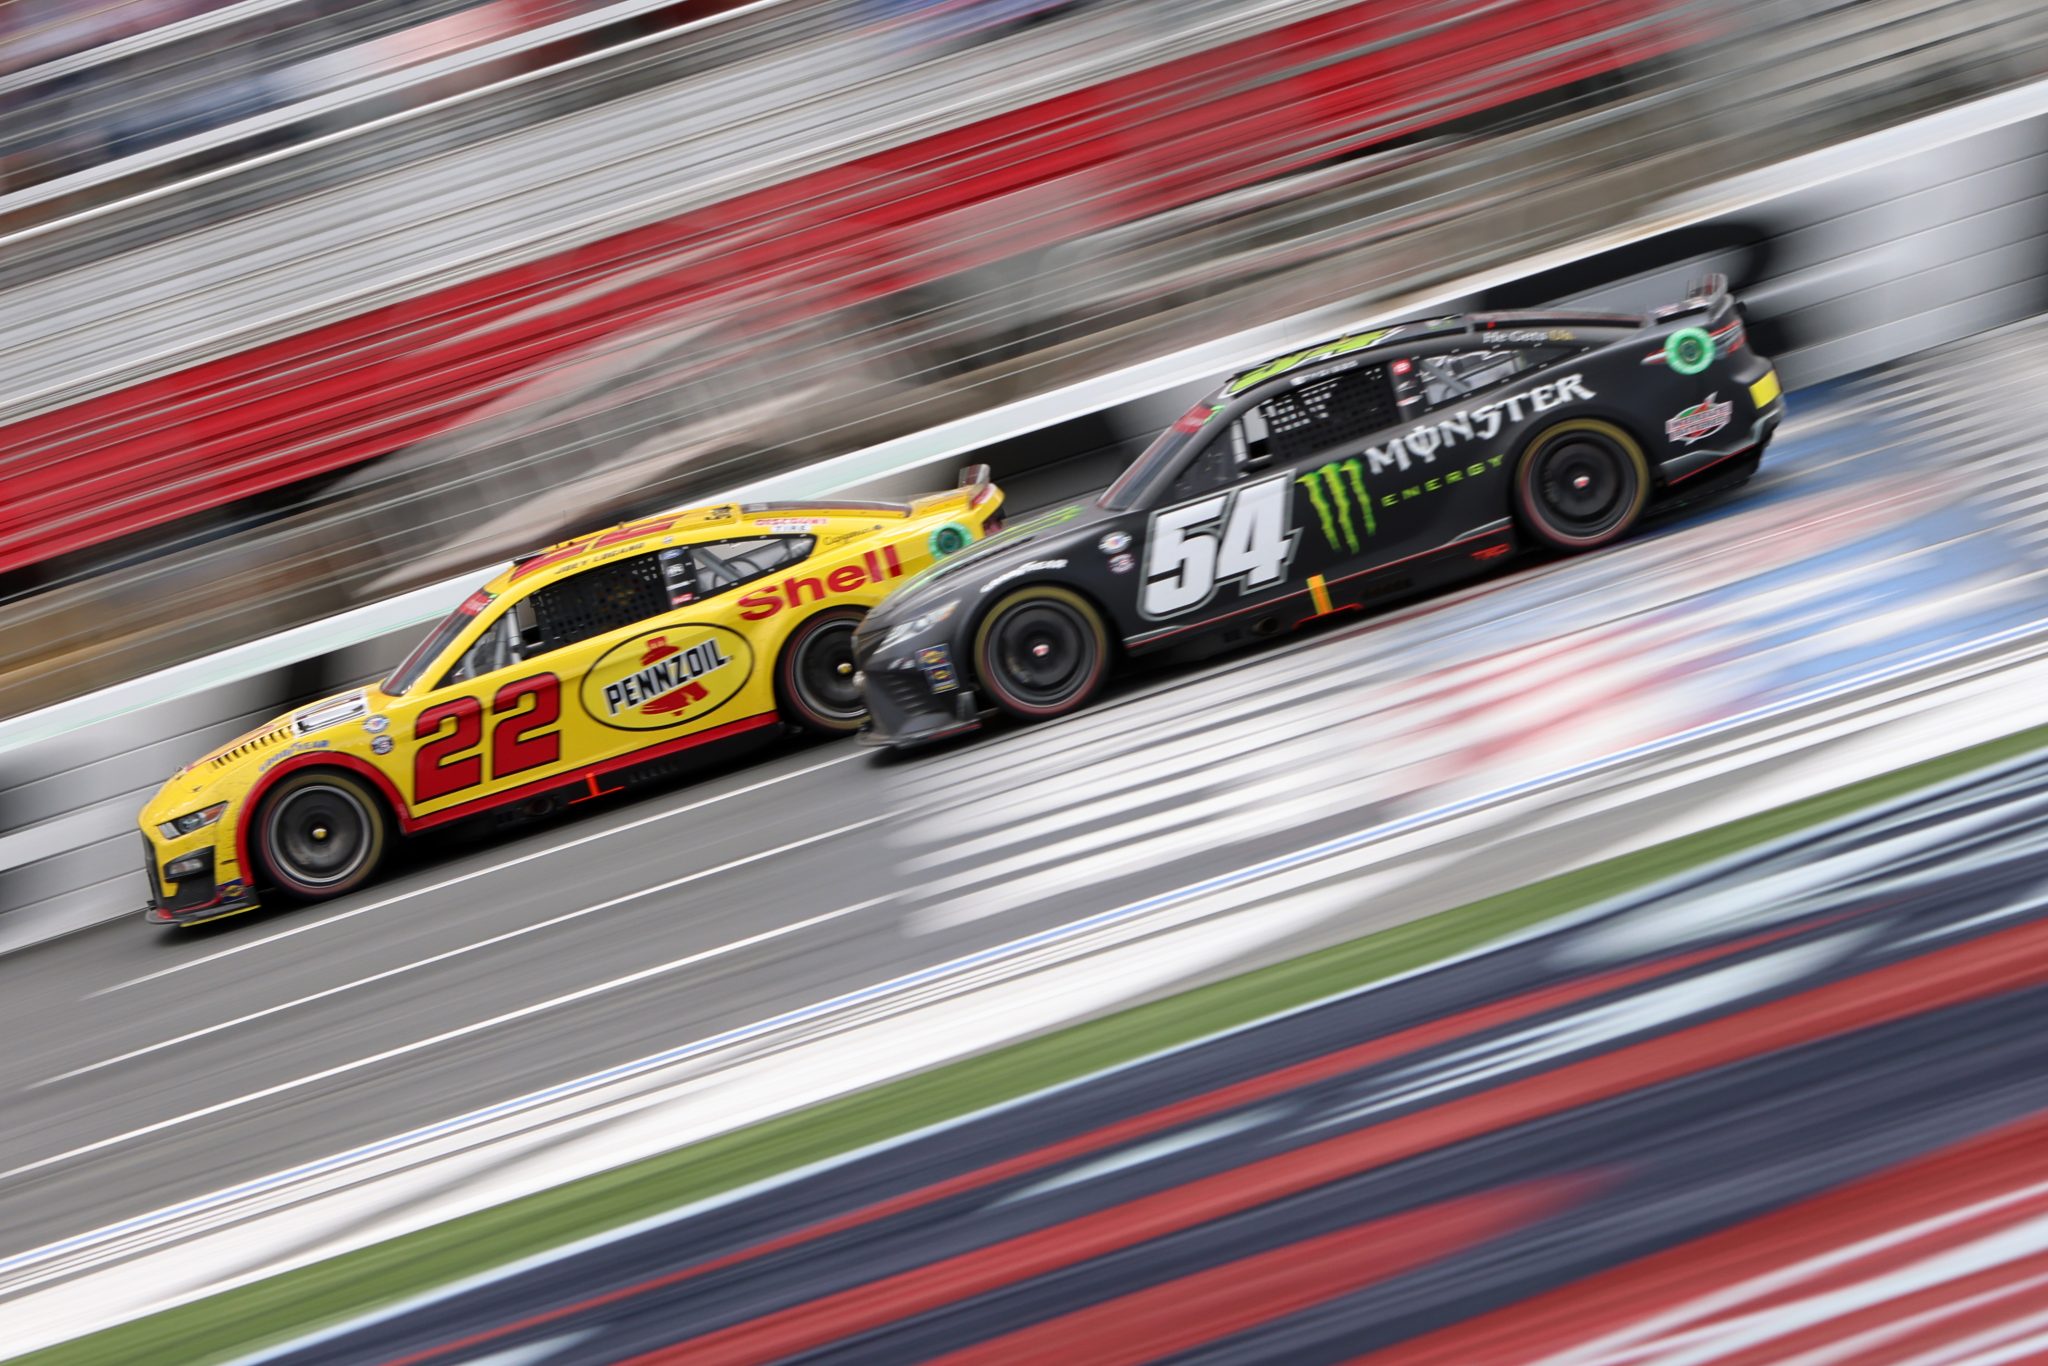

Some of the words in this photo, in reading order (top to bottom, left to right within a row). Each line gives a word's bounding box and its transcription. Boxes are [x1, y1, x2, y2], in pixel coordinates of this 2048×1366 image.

[1364, 373, 1597, 475] MONSTER
[1381, 454, 1504, 507] ENERGY
[738, 545, 903, 621] Shell
[1138, 470, 1302, 620] 54
[603, 638, 732, 717] PENNZOIL
[414, 671, 561, 805] 22
